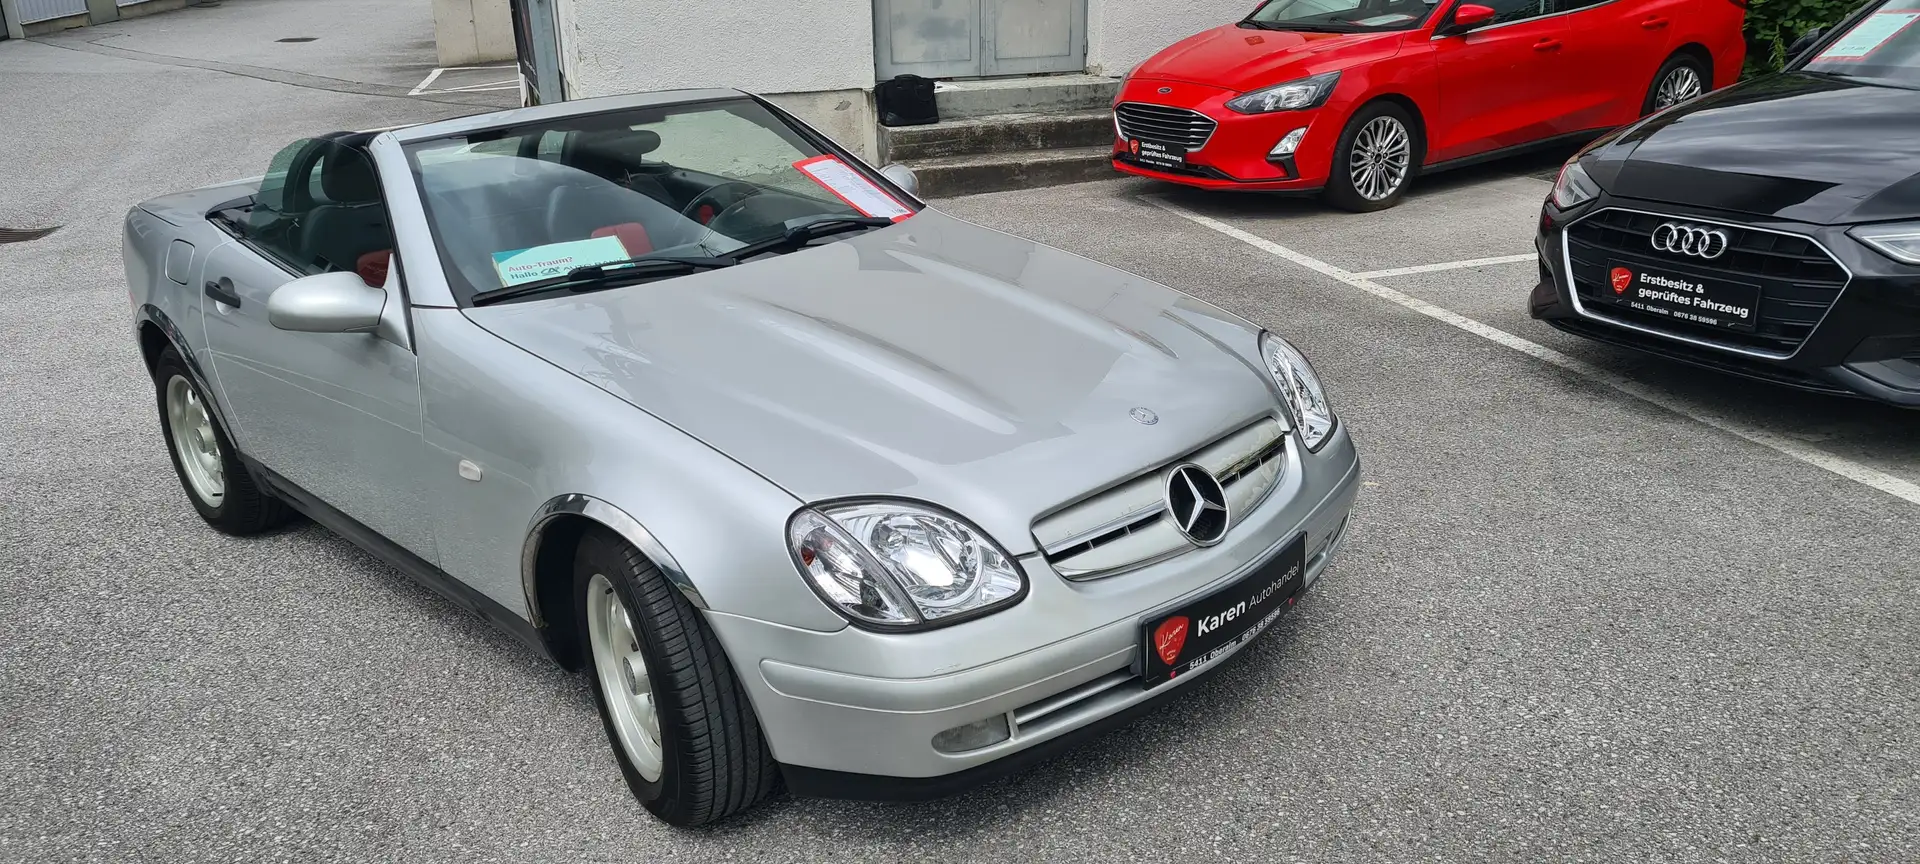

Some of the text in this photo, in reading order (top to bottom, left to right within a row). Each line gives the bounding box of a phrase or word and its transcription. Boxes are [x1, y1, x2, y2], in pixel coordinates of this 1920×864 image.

[508, 256, 573, 273] Auto-Traum?
[510, 270, 538, 280] Hallo
[1640, 273, 1693, 292] Erstbesitz
[1696, 284, 1704, 294] &
[1631, 301, 1644, 310] 5411
[1646, 305, 1669, 315] Oberalm
[1638, 287, 1749, 318] geprüftes Fahrzeug
[1197, 560, 1300, 637] Karen Autohandel
[1189, 655, 1207, 670] 5411
[1210, 641, 1237, 659] Oberalm
